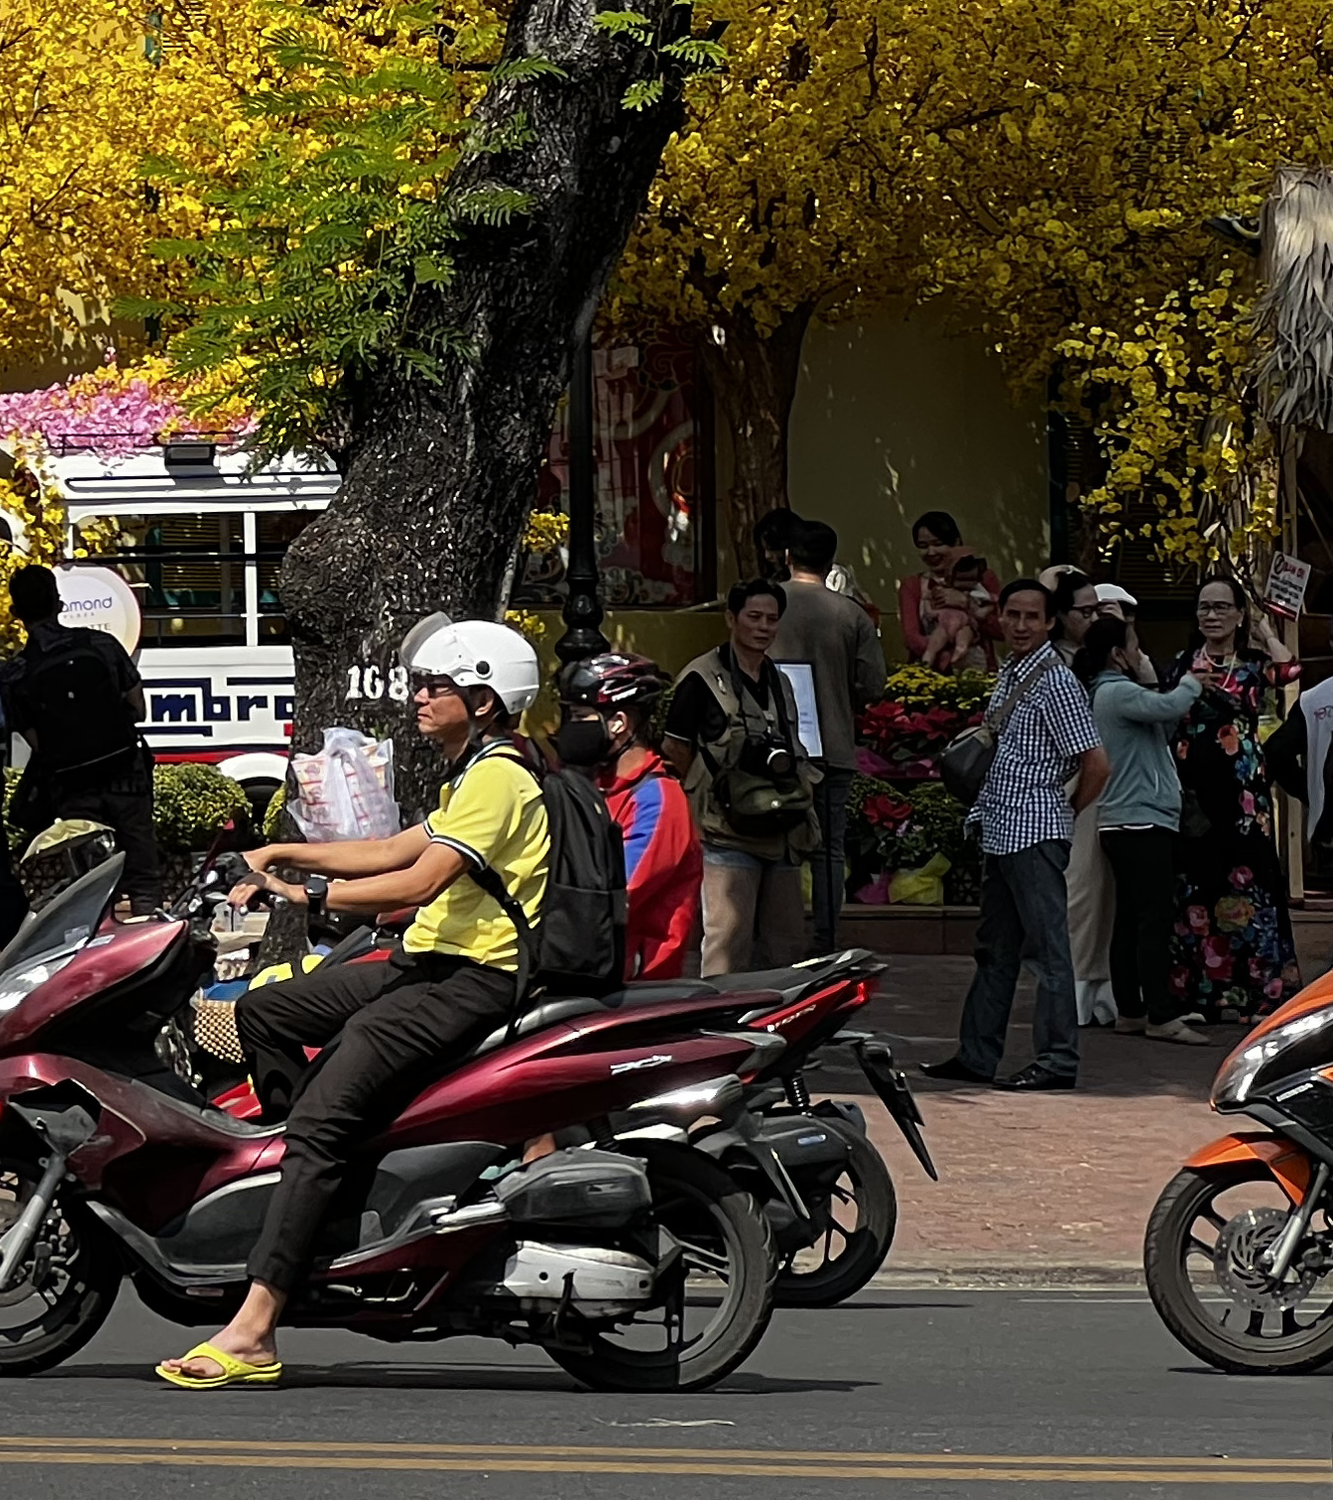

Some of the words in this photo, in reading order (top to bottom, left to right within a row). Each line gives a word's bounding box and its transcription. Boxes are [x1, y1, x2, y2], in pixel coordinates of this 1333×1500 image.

[62, 596, 113, 613] amond
[150, 680, 294, 722] mbro
[345, 664, 410, 702] 168
